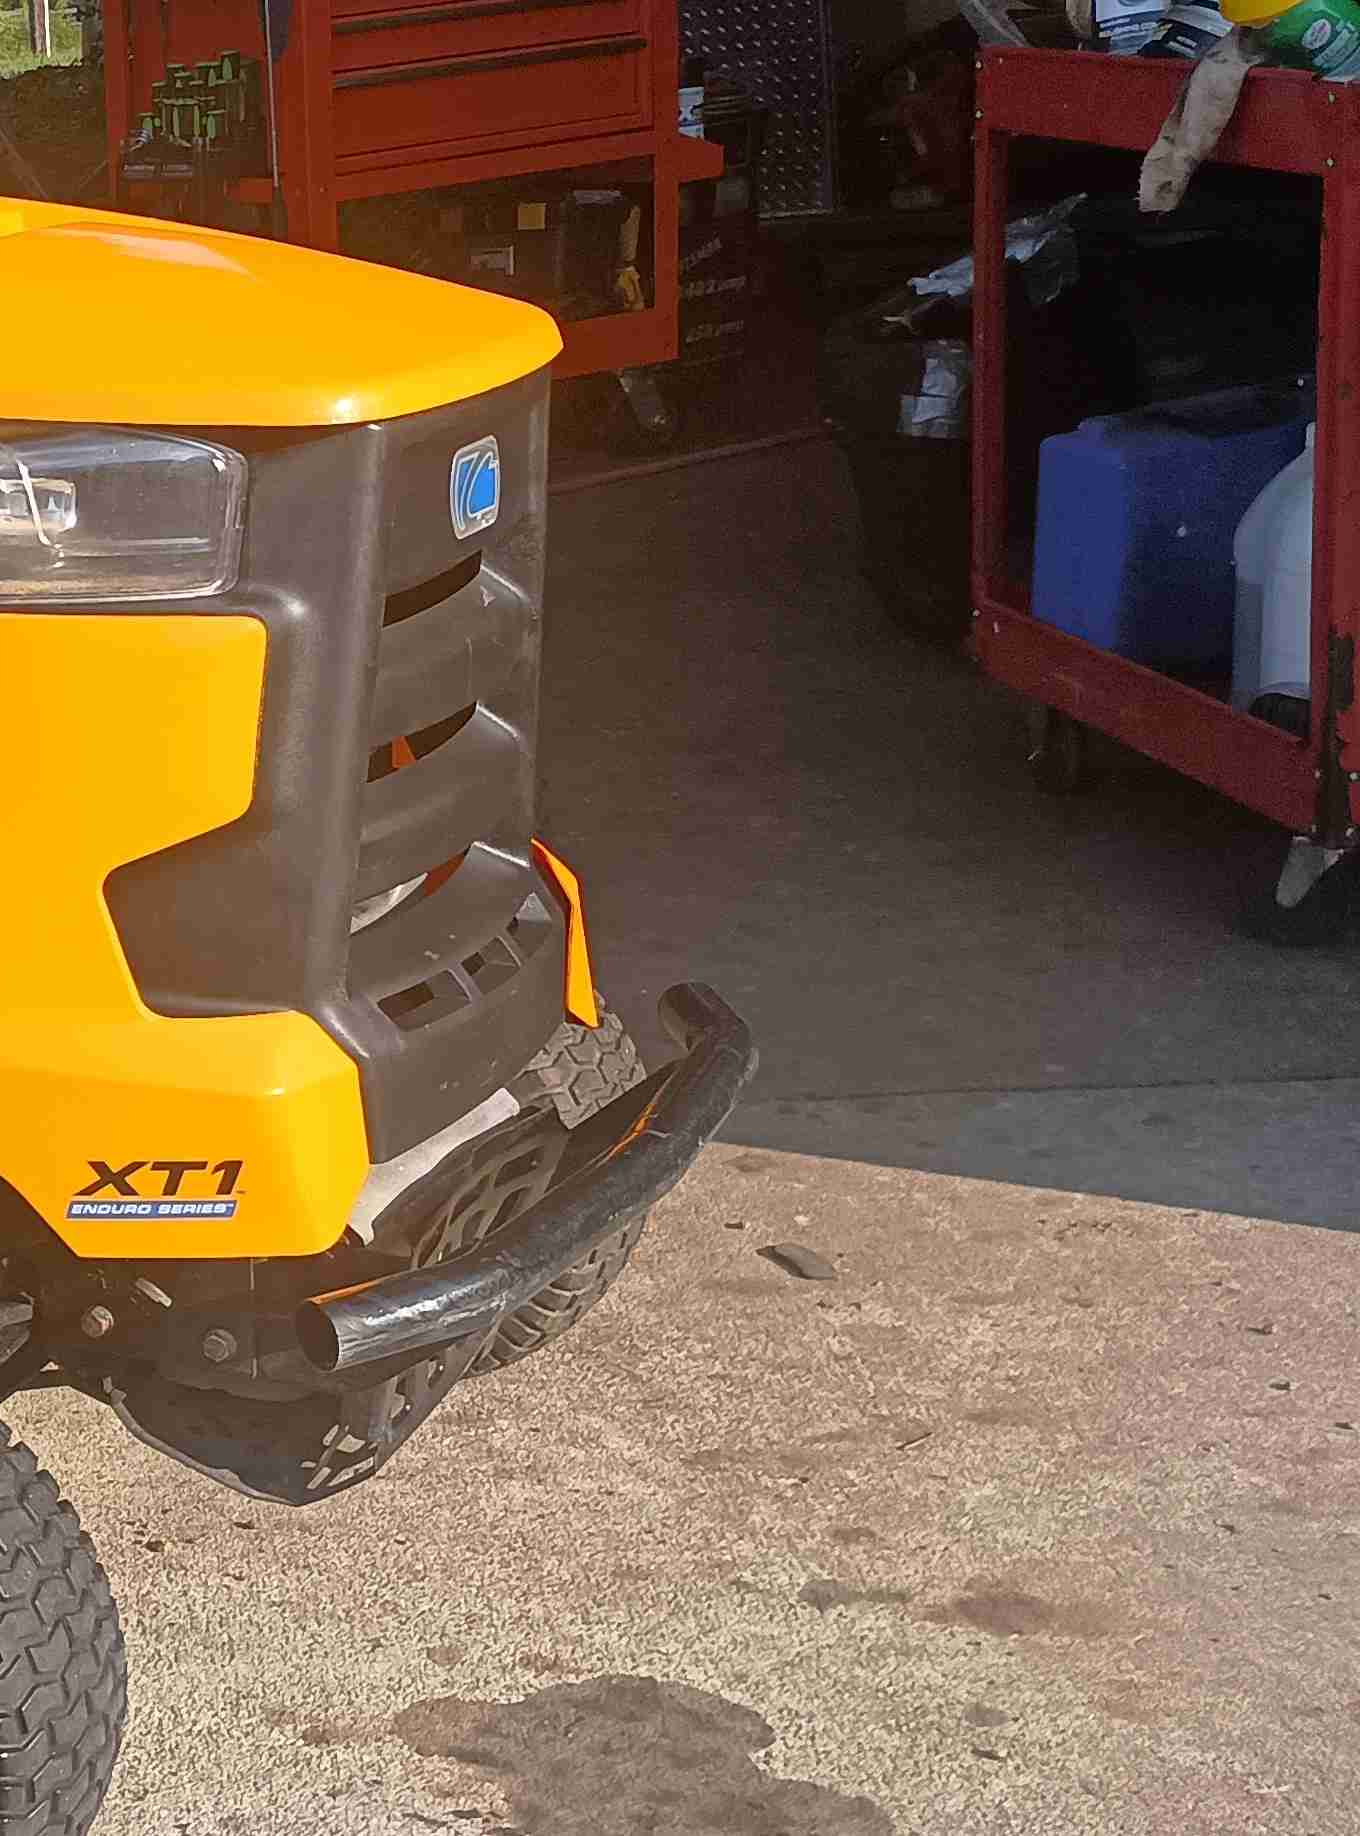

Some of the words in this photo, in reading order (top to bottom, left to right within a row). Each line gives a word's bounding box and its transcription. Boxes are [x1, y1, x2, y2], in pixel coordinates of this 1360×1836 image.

[73, 1160, 243, 1196] XT1
[71, 1203, 151, 1215] ENDURO
[157, 1203, 231, 1215] SERIES
